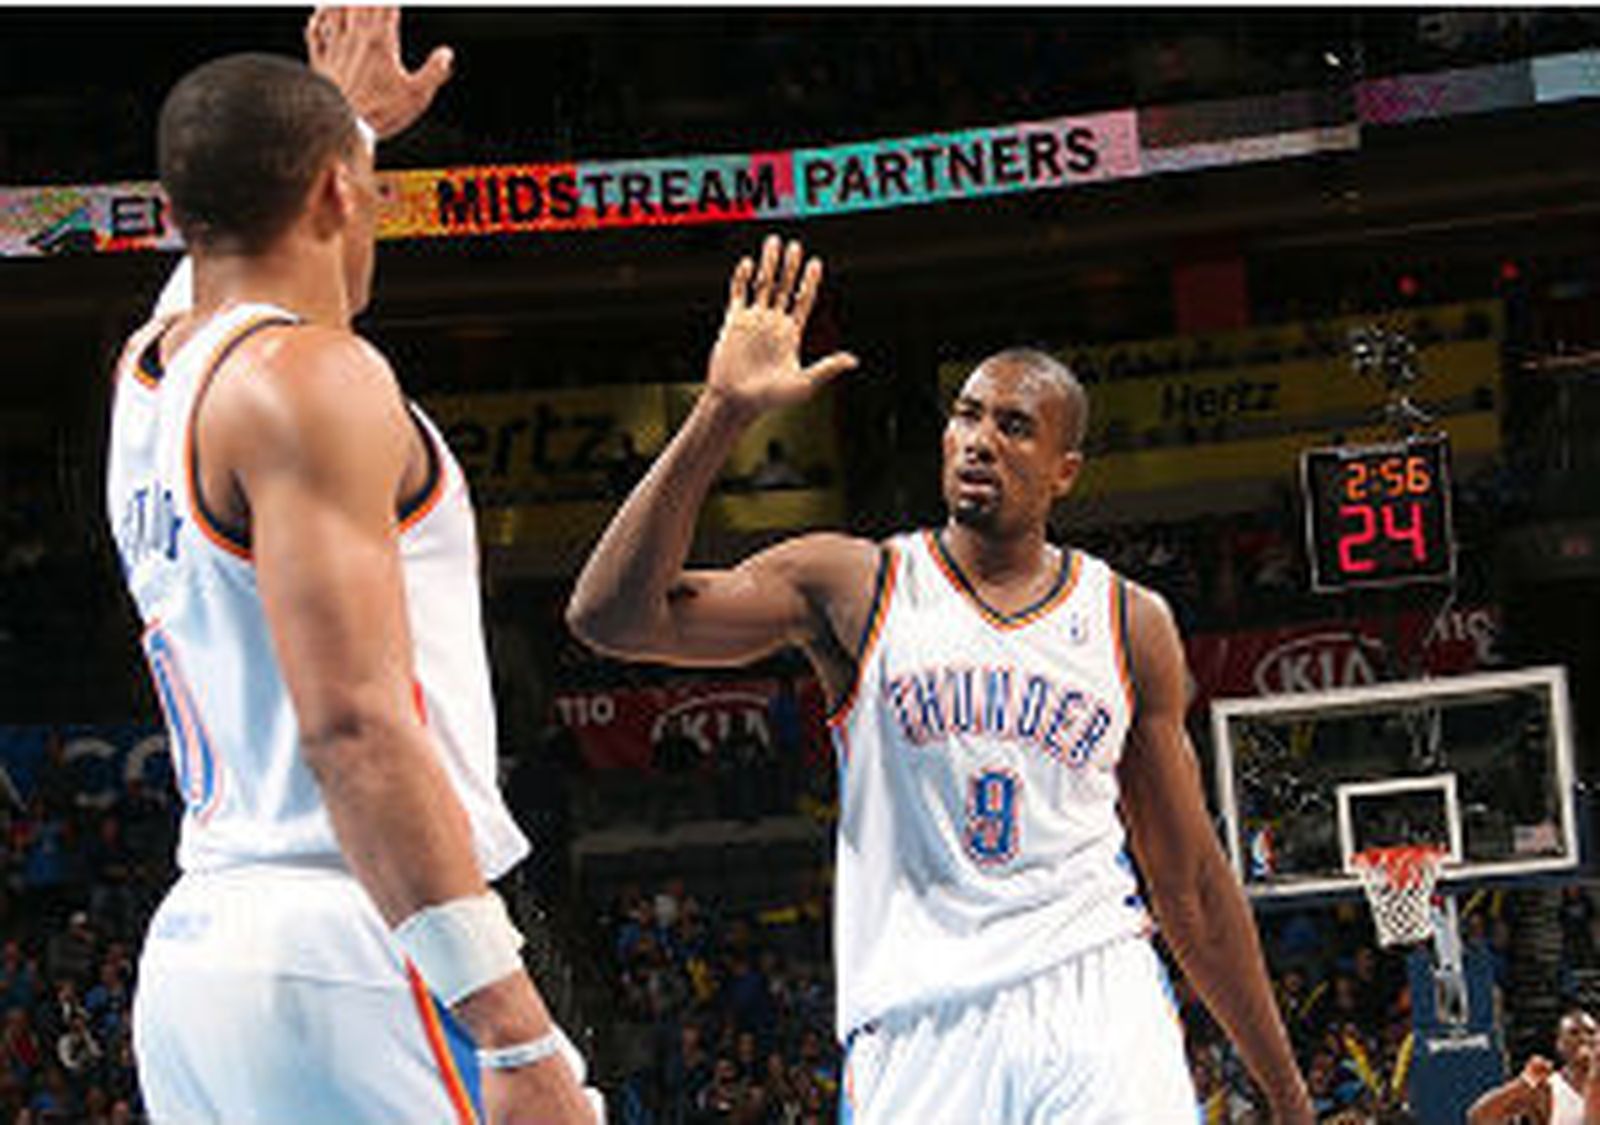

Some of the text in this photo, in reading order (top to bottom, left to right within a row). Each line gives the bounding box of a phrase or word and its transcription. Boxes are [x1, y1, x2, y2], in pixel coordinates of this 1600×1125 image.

[436, 165, 779, 226] MIDSTREAM
[803, 127, 1097, 205] PARTNERS
[1161, 377, 1280, 418] Hertz
[447, 403, 611, 478] ertz
[1346, 457, 1431, 499] 2:56
[1337, 505, 1427, 572] 24
[1278, 646, 1376, 688] KIA
[556, 696, 616, 726] 110
[887, 666, 1111, 768] THUNDER
[965, 766, 1023, 867] 9
